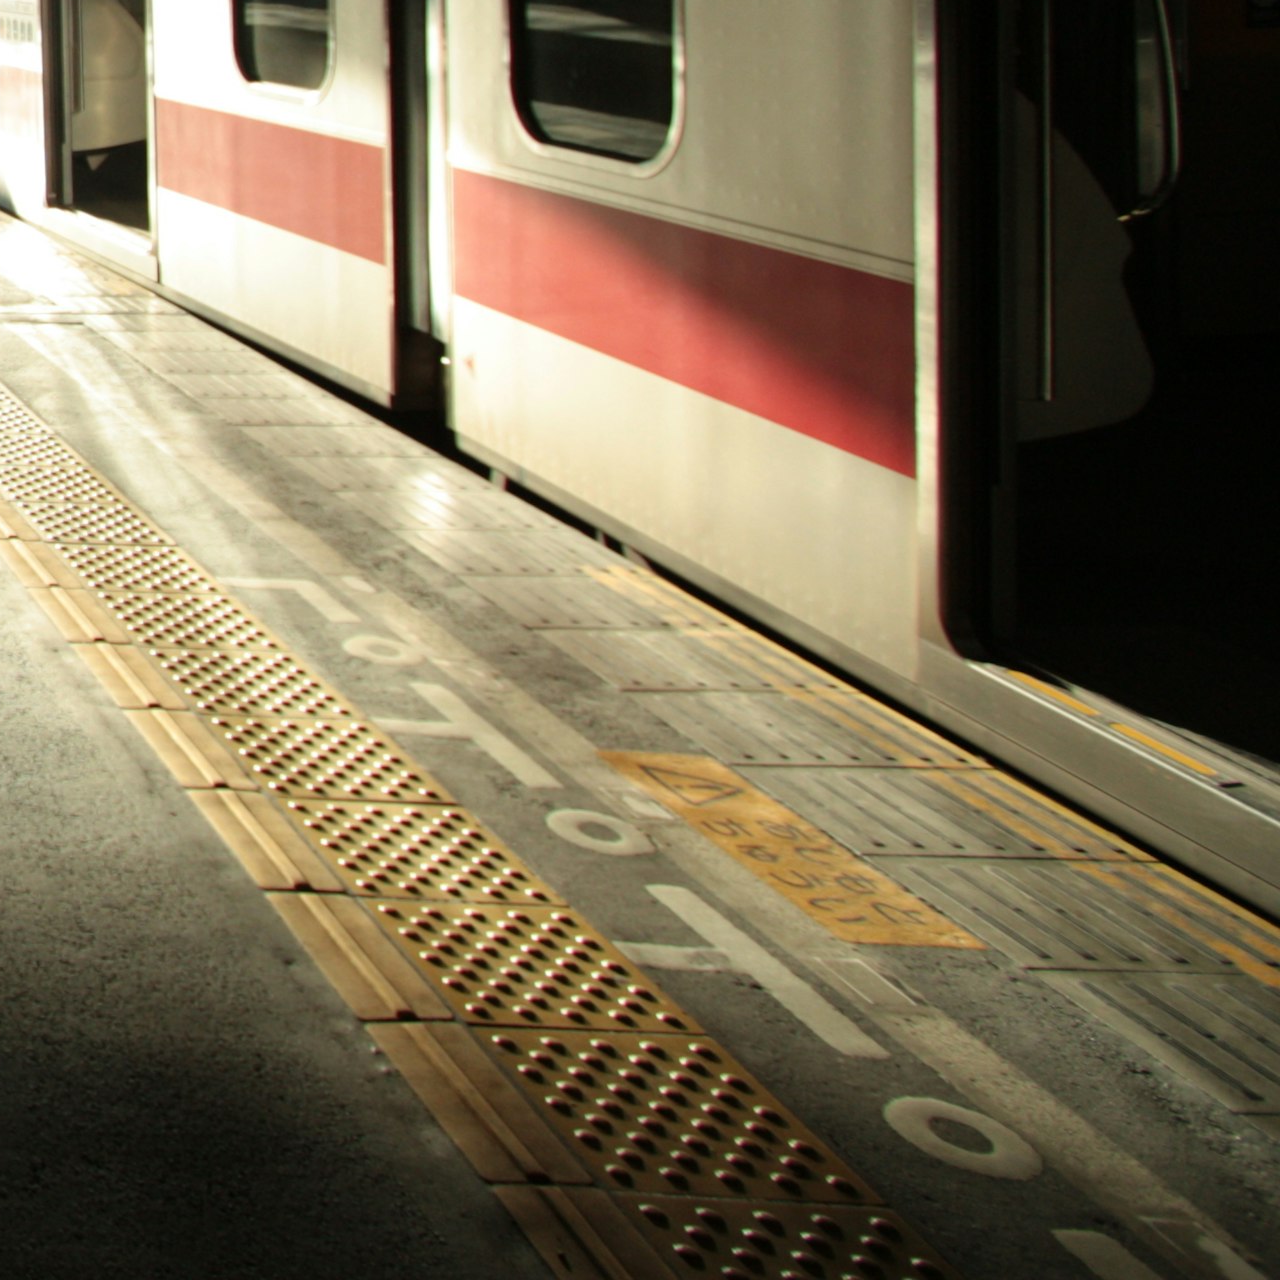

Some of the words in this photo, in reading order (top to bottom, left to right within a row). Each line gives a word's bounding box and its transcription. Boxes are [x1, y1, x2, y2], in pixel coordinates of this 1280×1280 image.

[701, 817, 867, 923] ちゅうい
[757, 819, 925, 925] あしもと
